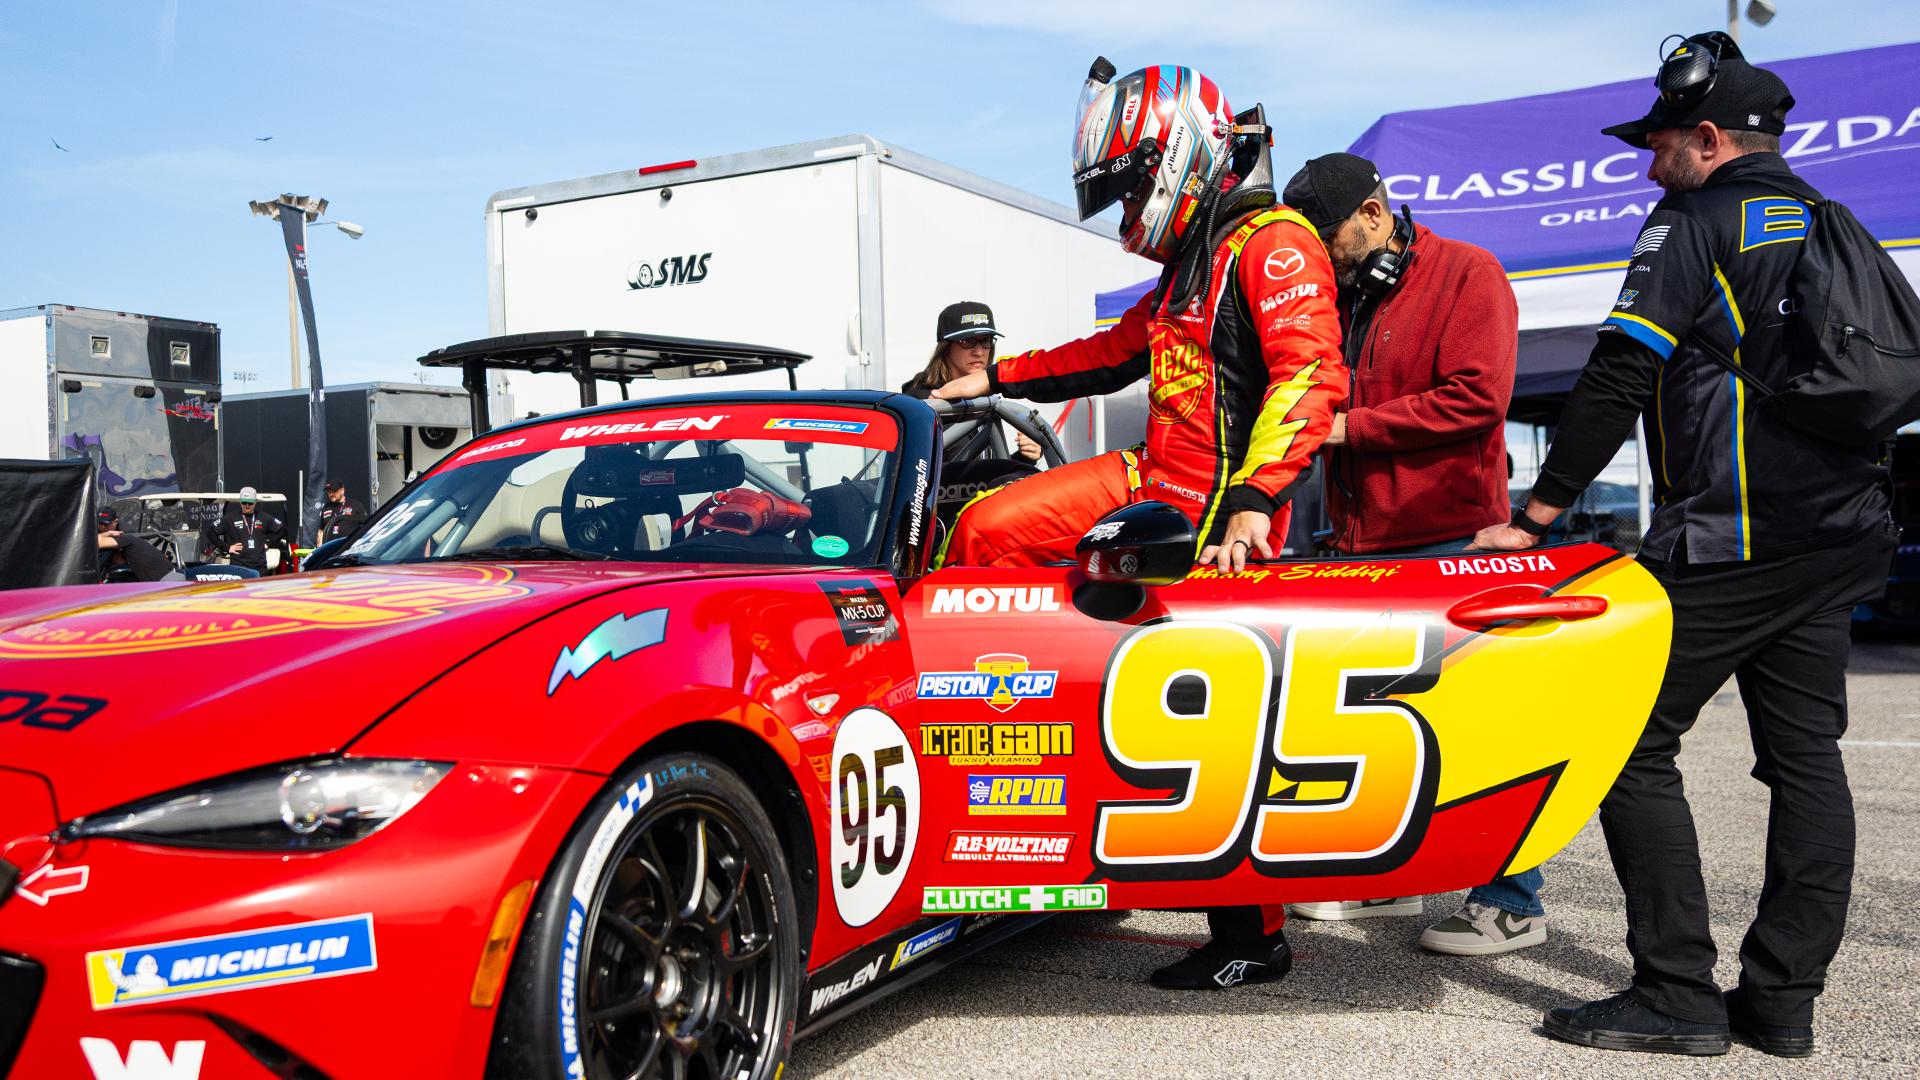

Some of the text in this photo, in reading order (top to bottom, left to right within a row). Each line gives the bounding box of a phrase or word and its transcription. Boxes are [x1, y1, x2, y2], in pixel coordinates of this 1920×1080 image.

[1125, 99, 1136, 121] BELL
[1384, 151, 1639, 201] CLASSIC
[654, 252, 712, 287] SMS
[1260, 283, 1319, 315] MOTUL
[559, 415, 725, 441] WHELEN
[792, 420, 859, 431] MICHELIN
[908, 458, 928, 546] www.kintsugi.fm
[1172, 485, 1206, 504] DACOSTA
[1279, 564, 1402, 582] Siddiqi
[1438, 554, 1556, 577] DACOSTA
[841, 604, 885, 621] MX-5 CUP
[930, 587, 1061, 613] MOTUL
[87, 618, 251, 643] FORMULA
[921, 673, 1055, 696] PISTON CUP
[1094, 618, 1434, 872] 95
[989, 778, 1065, 805] RPM
[839, 744, 908, 889] 95
[951, 853, 1065, 862] REBUILT ALTERNATORS
[923, 888, 1101, 909] CLUTCH AID
[911, 926, 955, 954] MICHELIN
[170, 935, 350, 982] MICHELIN
[560, 910, 584, 1053] MICHELIN
[809, 954, 884, 1016] WHELEN
